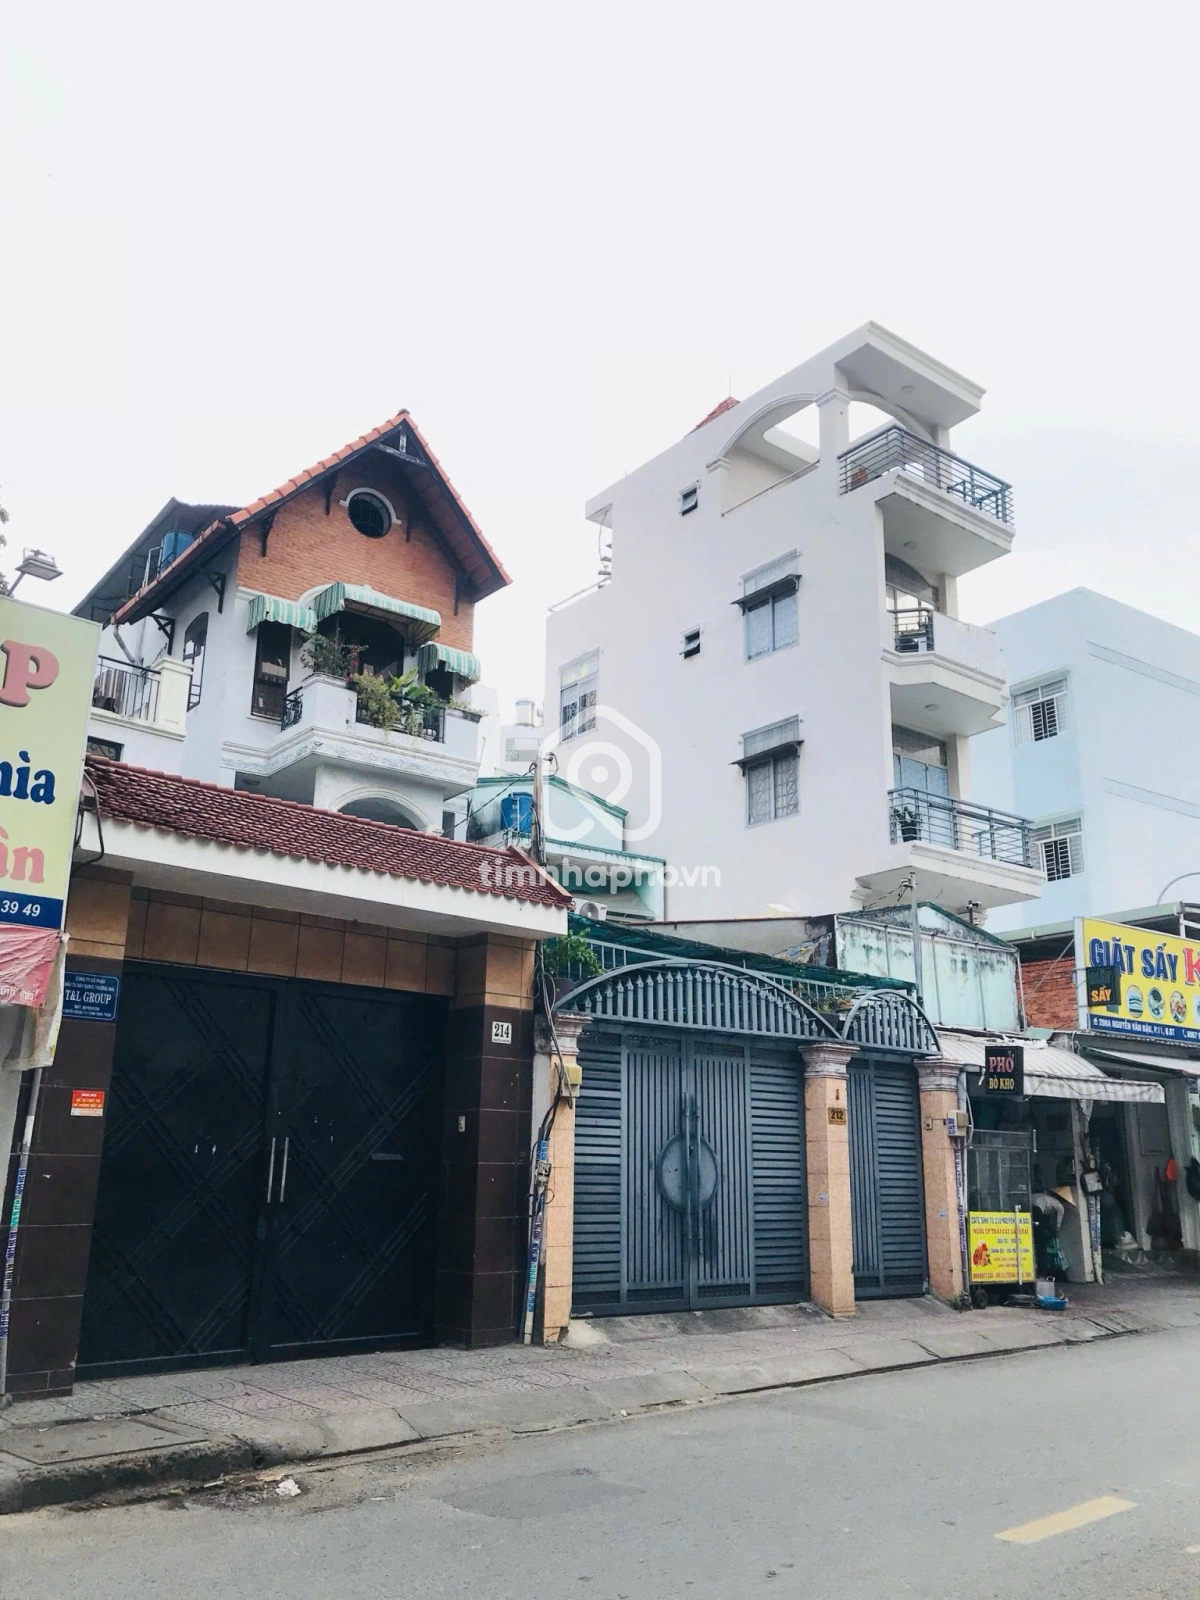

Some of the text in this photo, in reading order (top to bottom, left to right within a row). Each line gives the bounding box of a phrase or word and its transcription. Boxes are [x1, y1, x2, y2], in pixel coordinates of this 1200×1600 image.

[1, 900, 41, 917] 39 49
[1141, 943, 1178, 982] SẤY
[65, 989, 112, 1004] T&L GROUP
[1091, 985, 1112, 1002] SẤY
[494, 1023, 510, 1038] 214
[999, 1078, 1015, 1090] KHO
[830, 1110, 844, 1120] 212
